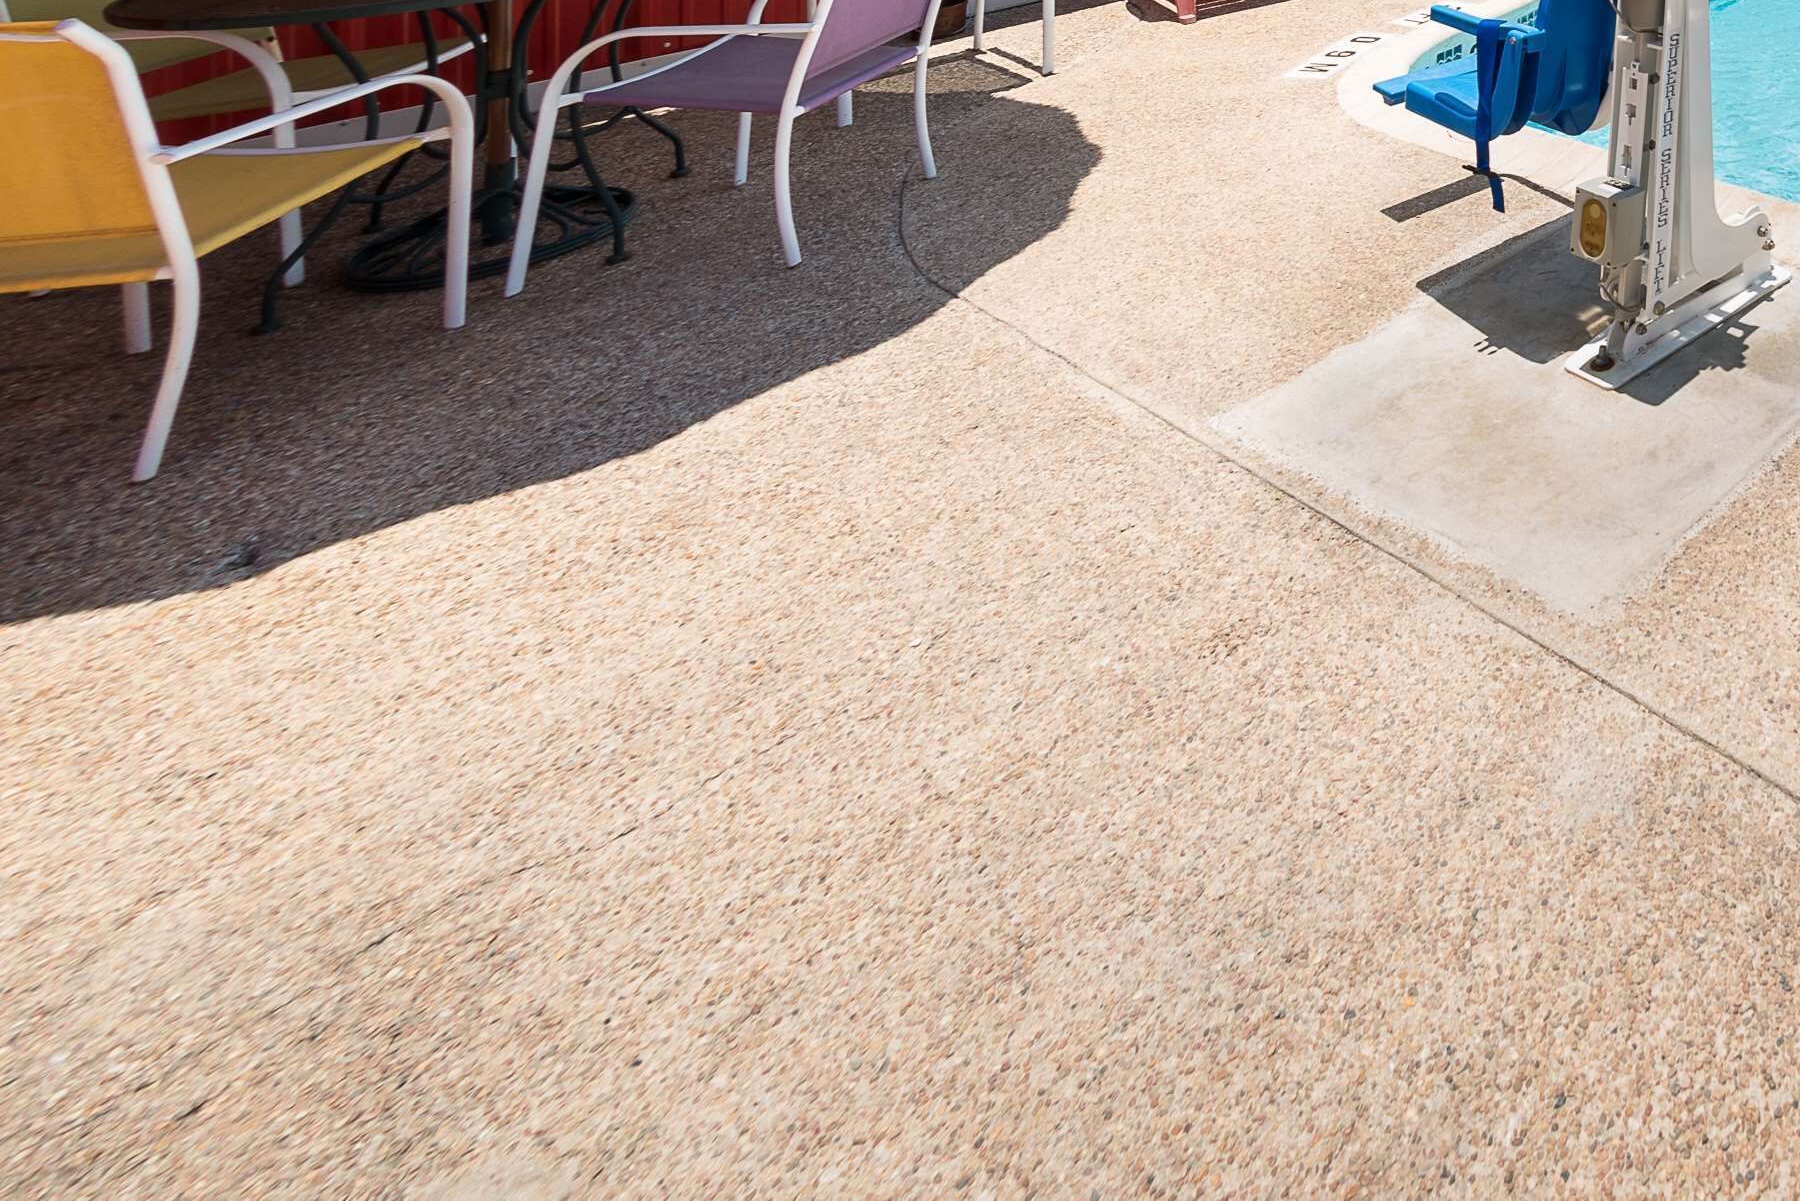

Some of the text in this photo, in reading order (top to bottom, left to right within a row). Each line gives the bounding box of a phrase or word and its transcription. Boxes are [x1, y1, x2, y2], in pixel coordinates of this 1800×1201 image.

[1653, 33, 1680, 295] SUPERIOR SERIES LIFT
